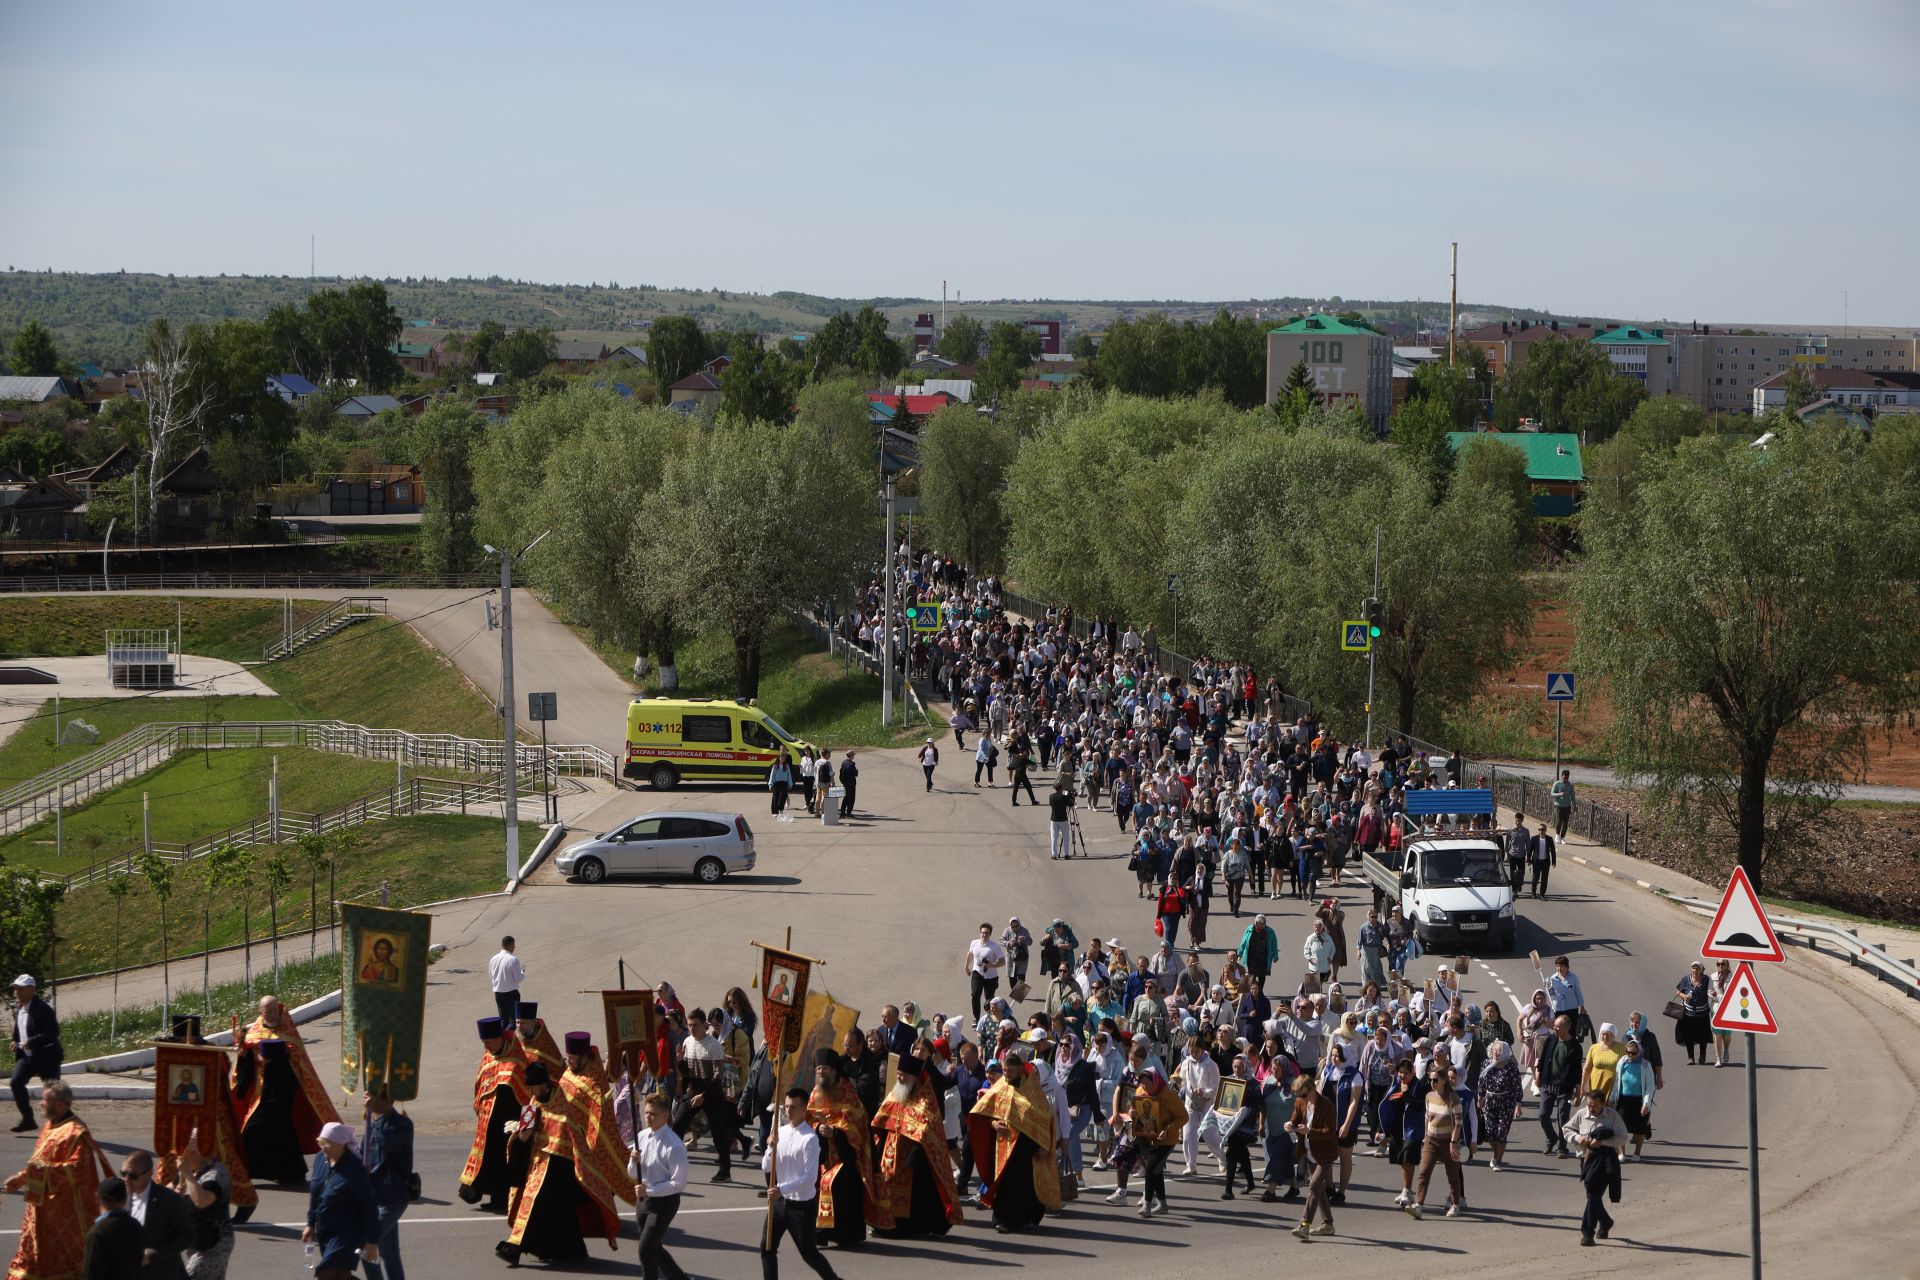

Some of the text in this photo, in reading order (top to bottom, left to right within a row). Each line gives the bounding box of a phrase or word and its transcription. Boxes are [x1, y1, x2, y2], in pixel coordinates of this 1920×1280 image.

[1299, 341, 1343, 363] 100
[638, 722, 682, 733] 03 112
